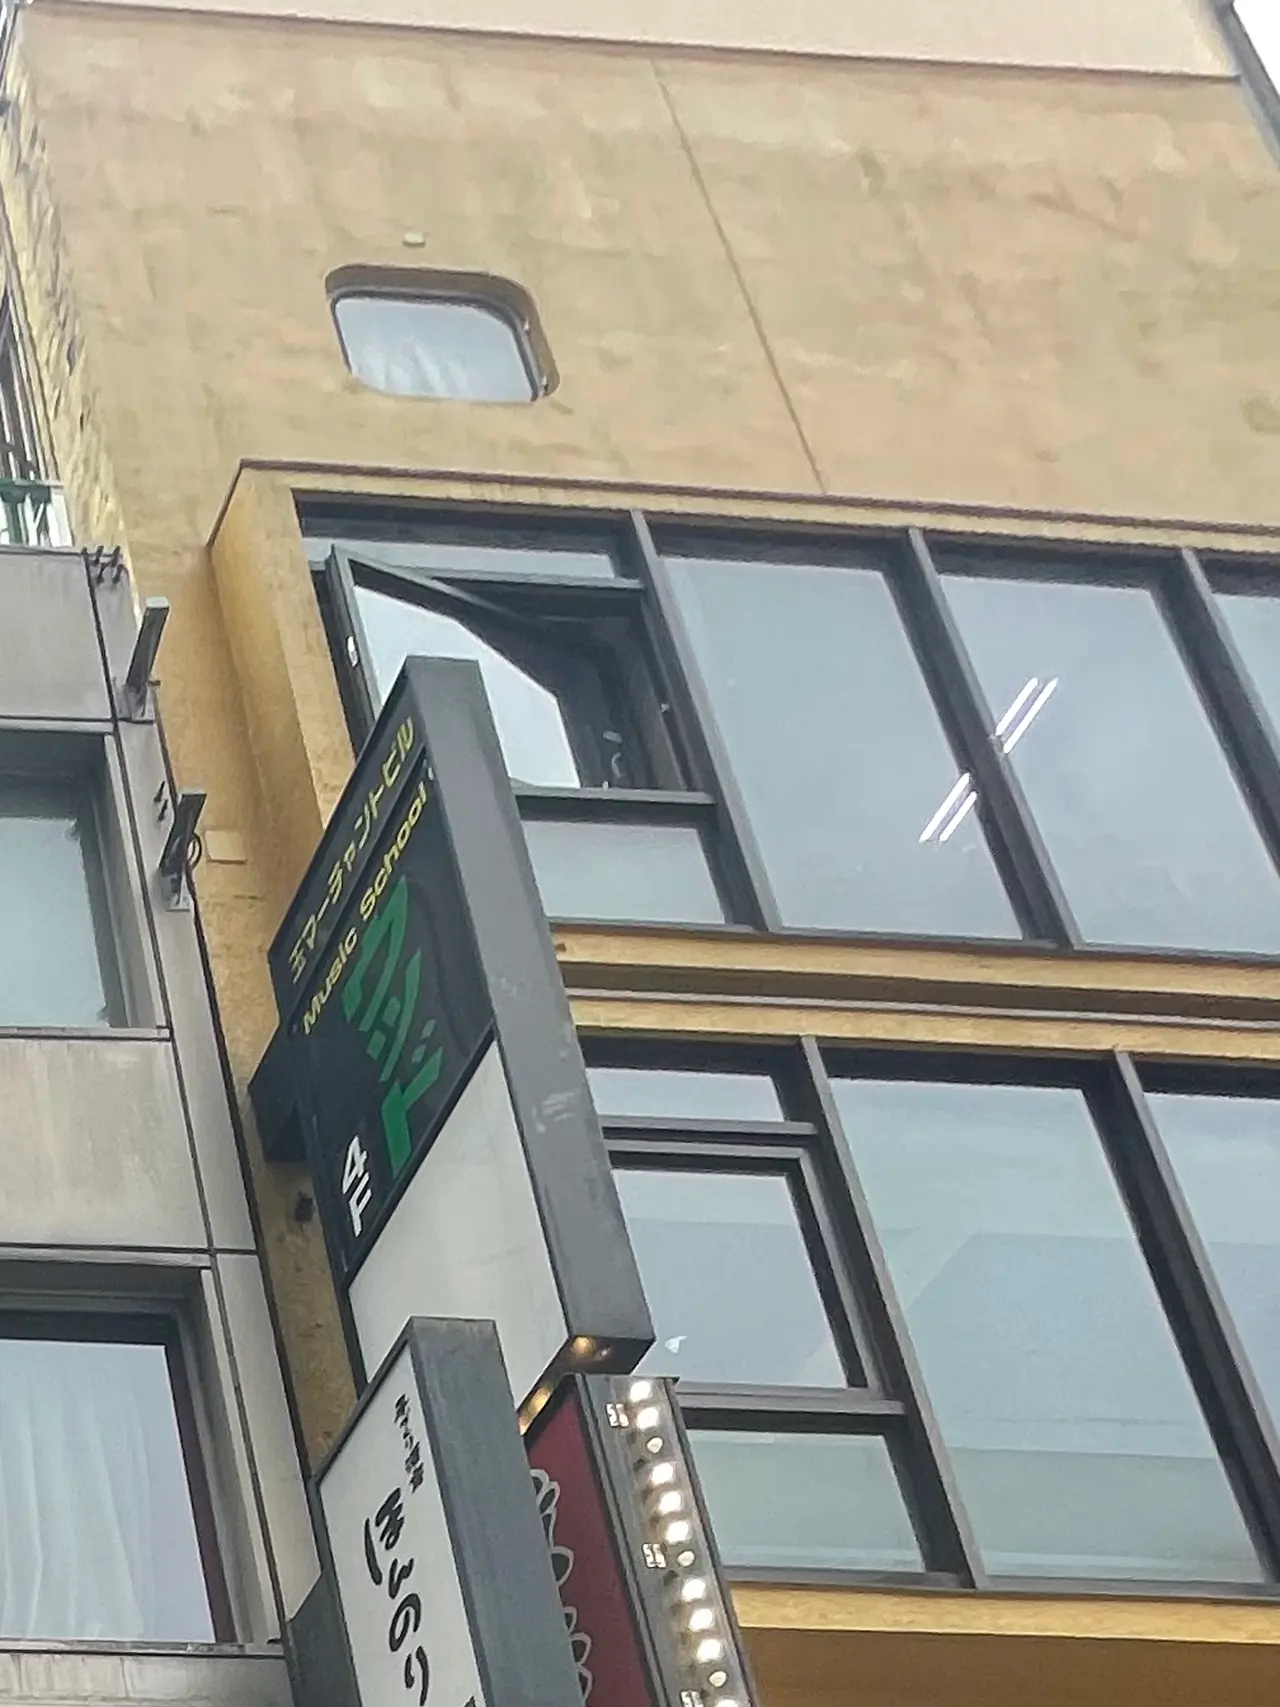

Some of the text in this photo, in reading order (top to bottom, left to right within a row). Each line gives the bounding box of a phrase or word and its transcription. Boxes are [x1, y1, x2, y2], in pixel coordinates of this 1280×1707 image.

[301, 786, 430, 1037] Music School
[343, 875, 445, 1178] ウッド
[362, 1485, 433, 1707] ほんのり
